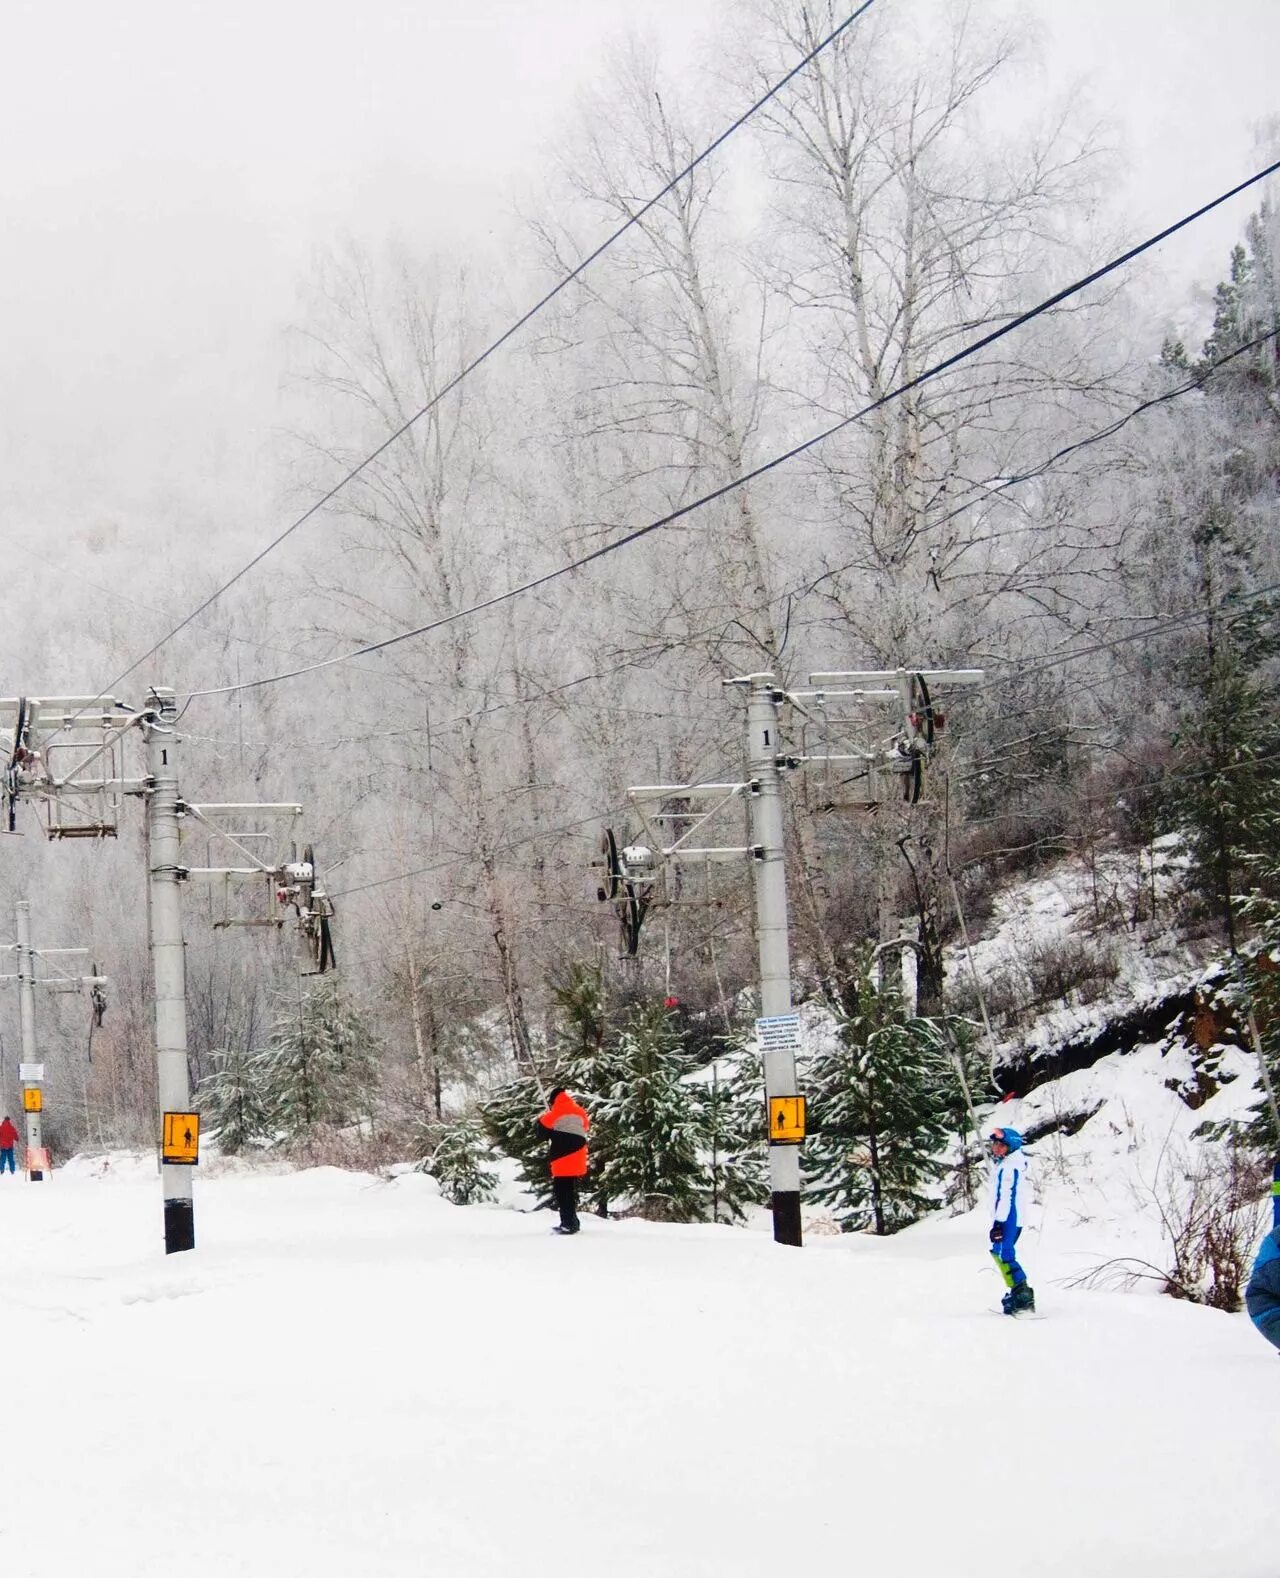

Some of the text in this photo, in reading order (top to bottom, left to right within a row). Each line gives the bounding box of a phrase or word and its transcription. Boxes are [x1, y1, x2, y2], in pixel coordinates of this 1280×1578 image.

[762, 729, 771, 745] 1
[160, 748, 168, 765] 1
[32, 1127, 37, 1136] 2
